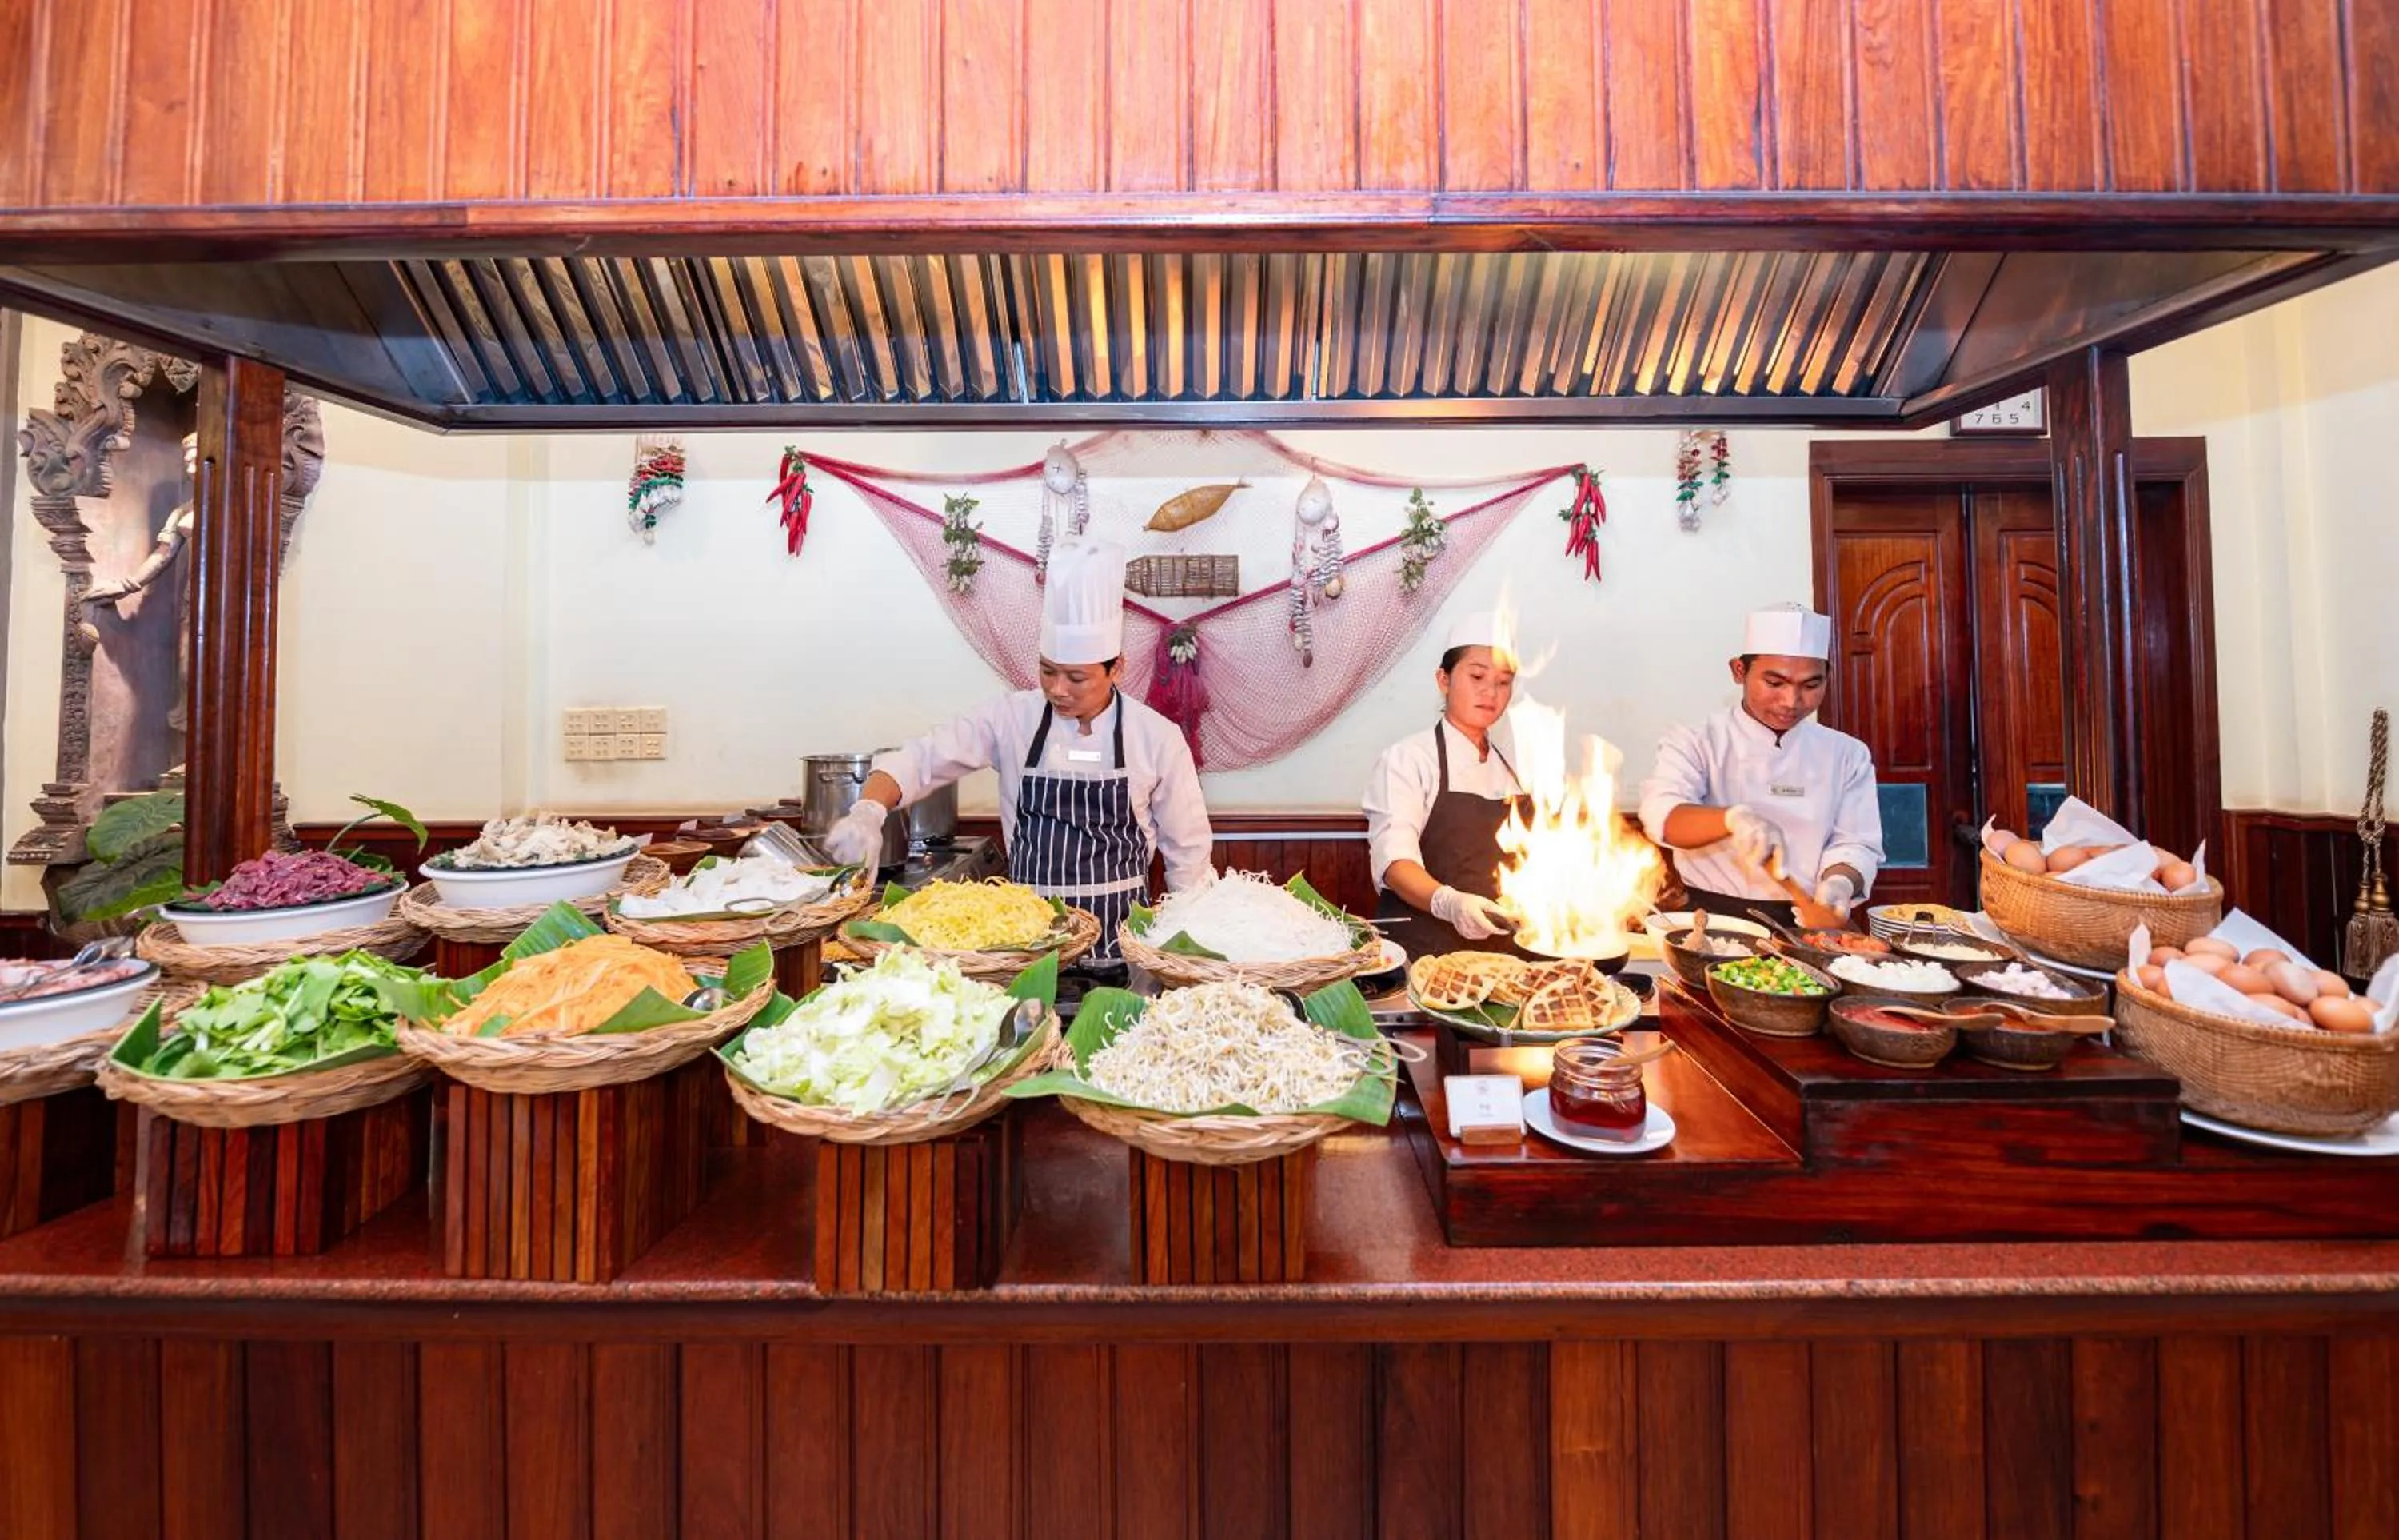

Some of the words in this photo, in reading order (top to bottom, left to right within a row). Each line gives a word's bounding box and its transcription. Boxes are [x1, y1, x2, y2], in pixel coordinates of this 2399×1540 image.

[1974, 413, 1983, 424] 7
[1992, 413, 2002, 424] 6
[2010, 413, 2019, 424] 5
